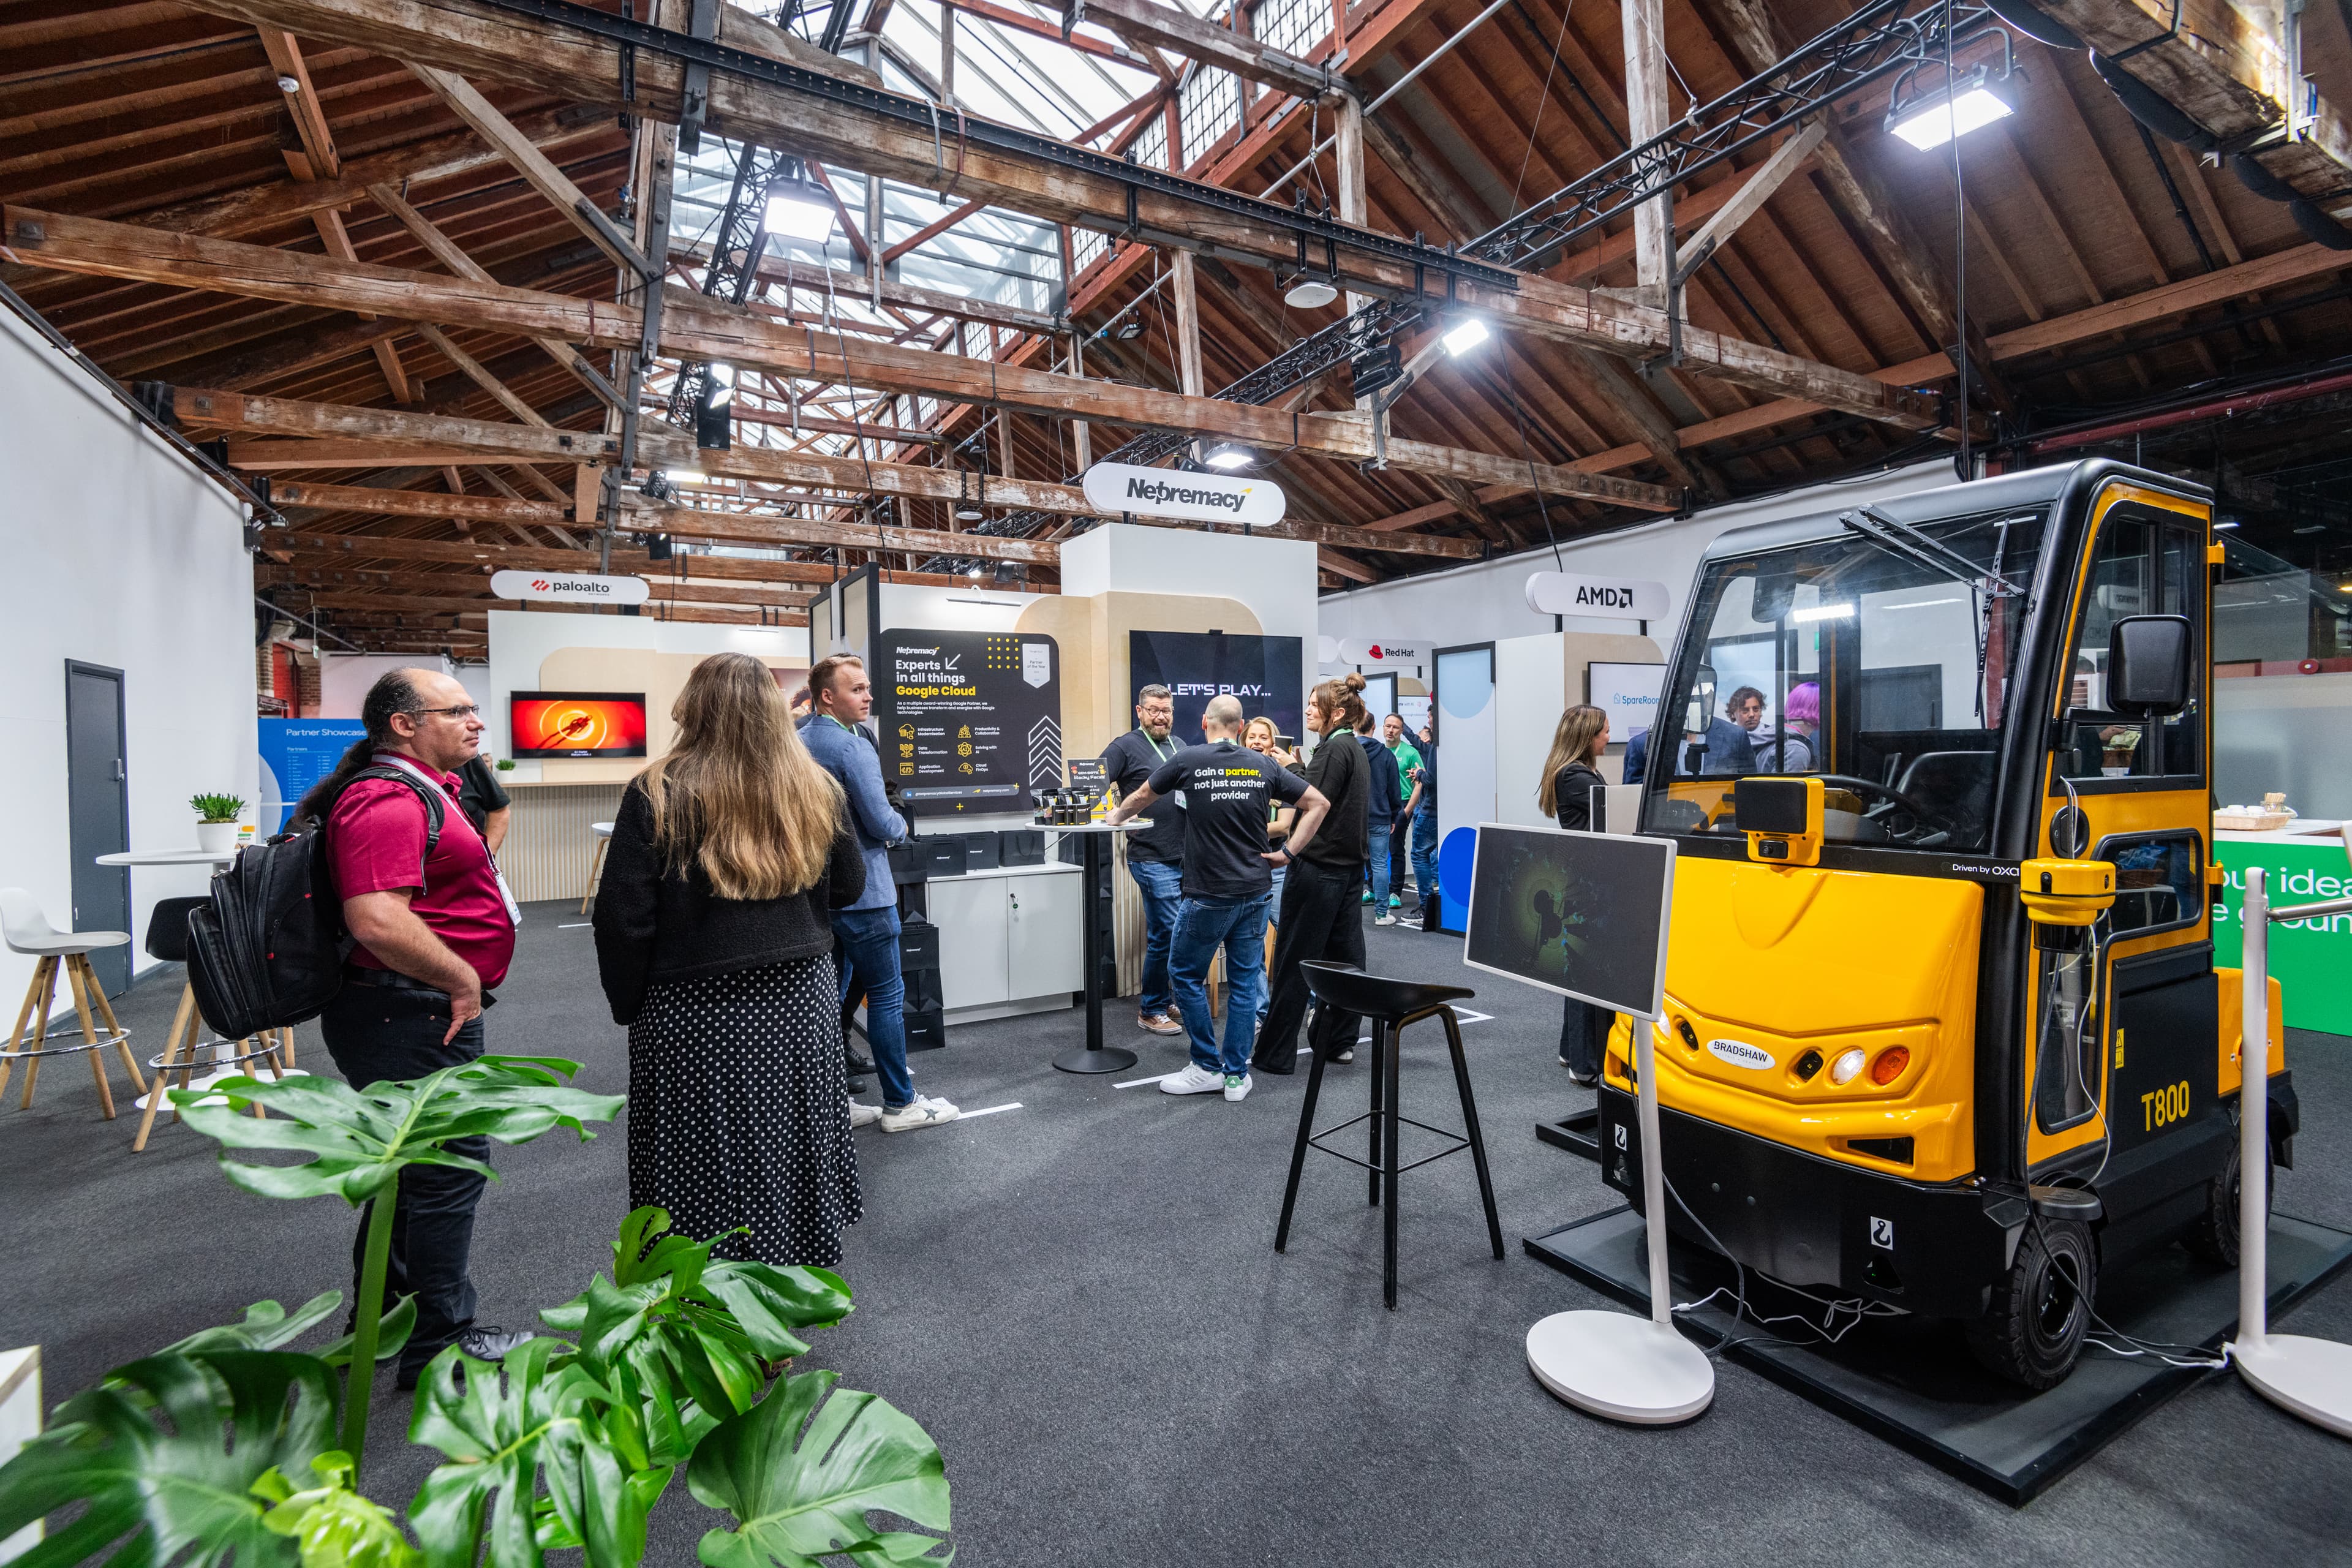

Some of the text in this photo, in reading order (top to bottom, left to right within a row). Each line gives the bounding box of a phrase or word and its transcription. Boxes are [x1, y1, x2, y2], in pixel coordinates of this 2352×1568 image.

[1126, 478, 1246, 512] Netpremacy
[553, 581, 609, 592] paloalto
[1576, 586, 1618, 606] AMD
[896, 647, 938, 655] Netpremacy
[1385, 648, 1414, 657] Red Hat
[895, 660, 940, 673] Experts
[896, 672, 965, 685] in all things
[896, 685, 976, 698] Google Cloud
[1167, 684, 1215, 696] LET'S
[1194, 767, 1216, 777] Gain
[1226, 768, 1261, 778] partner,
[1194, 778, 1265, 790] not just another
[1211, 790, 1250, 801] provider
[1953, 864, 1977, 872] Driven
[1980, 865, 1989, 874] by
[1713, 1041, 1768, 1062] BRADSHAW
[2141, 1080, 2189, 1132] T800
